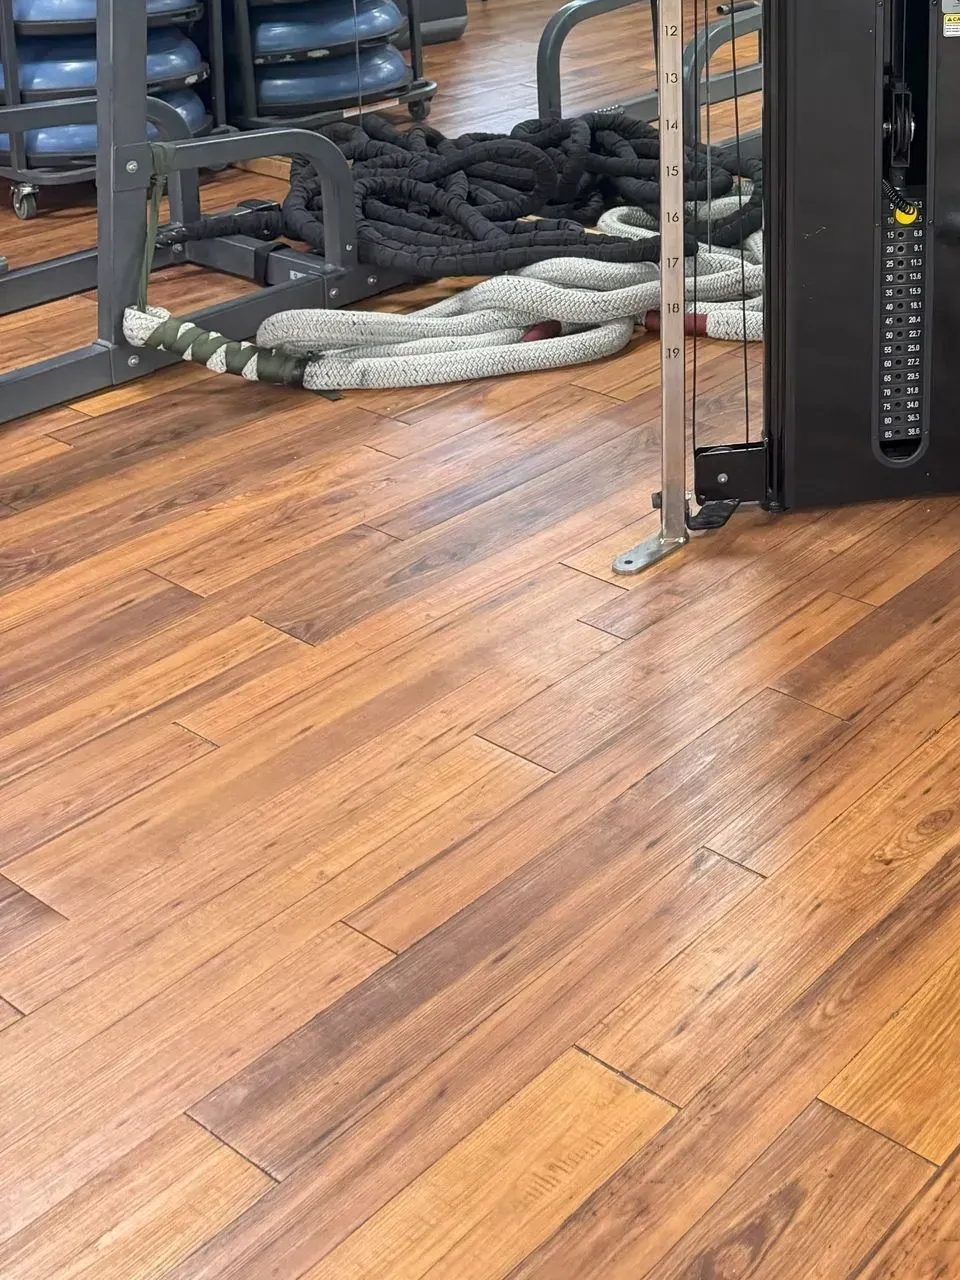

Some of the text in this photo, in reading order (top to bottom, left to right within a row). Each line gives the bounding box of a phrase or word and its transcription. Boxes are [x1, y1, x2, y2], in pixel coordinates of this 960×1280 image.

[664, 25, 678, 37] 12
[665, 72, 678, 84] 13
[666, 119, 679, 131] 14
[666, 165, 679, 177] 15
[666, 211, 680, 223] 16
[887, 229, 923, 239] 15 6.8
[886, 244, 923, 253] 20 9.1
[667, 257, 679, 269] 17
[886, 258, 922, 268] 25 11.3
[885, 272, 922, 282] 30 13.6
[885, 287, 922, 297] 35 15.9
[667, 302, 680, 314] 18
[885, 301, 922, 311] 40 18.1
[885, 316, 921, 325] 45 20.4
[885, 330, 921, 339] 50 22.7
[667, 348, 680, 360] 19
[884, 344, 920, 354] 55 25.0
[884, 358, 920, 368] 60 27.2
[883, 372, 920, 382] 65 29.5
[883, 386, 919, 397] 70 31.8
[883, 401, 919, 411] 75 34.0
[907, 414, 920, 422] 36.3
[884, 427, 920, 438] 85 38.6
